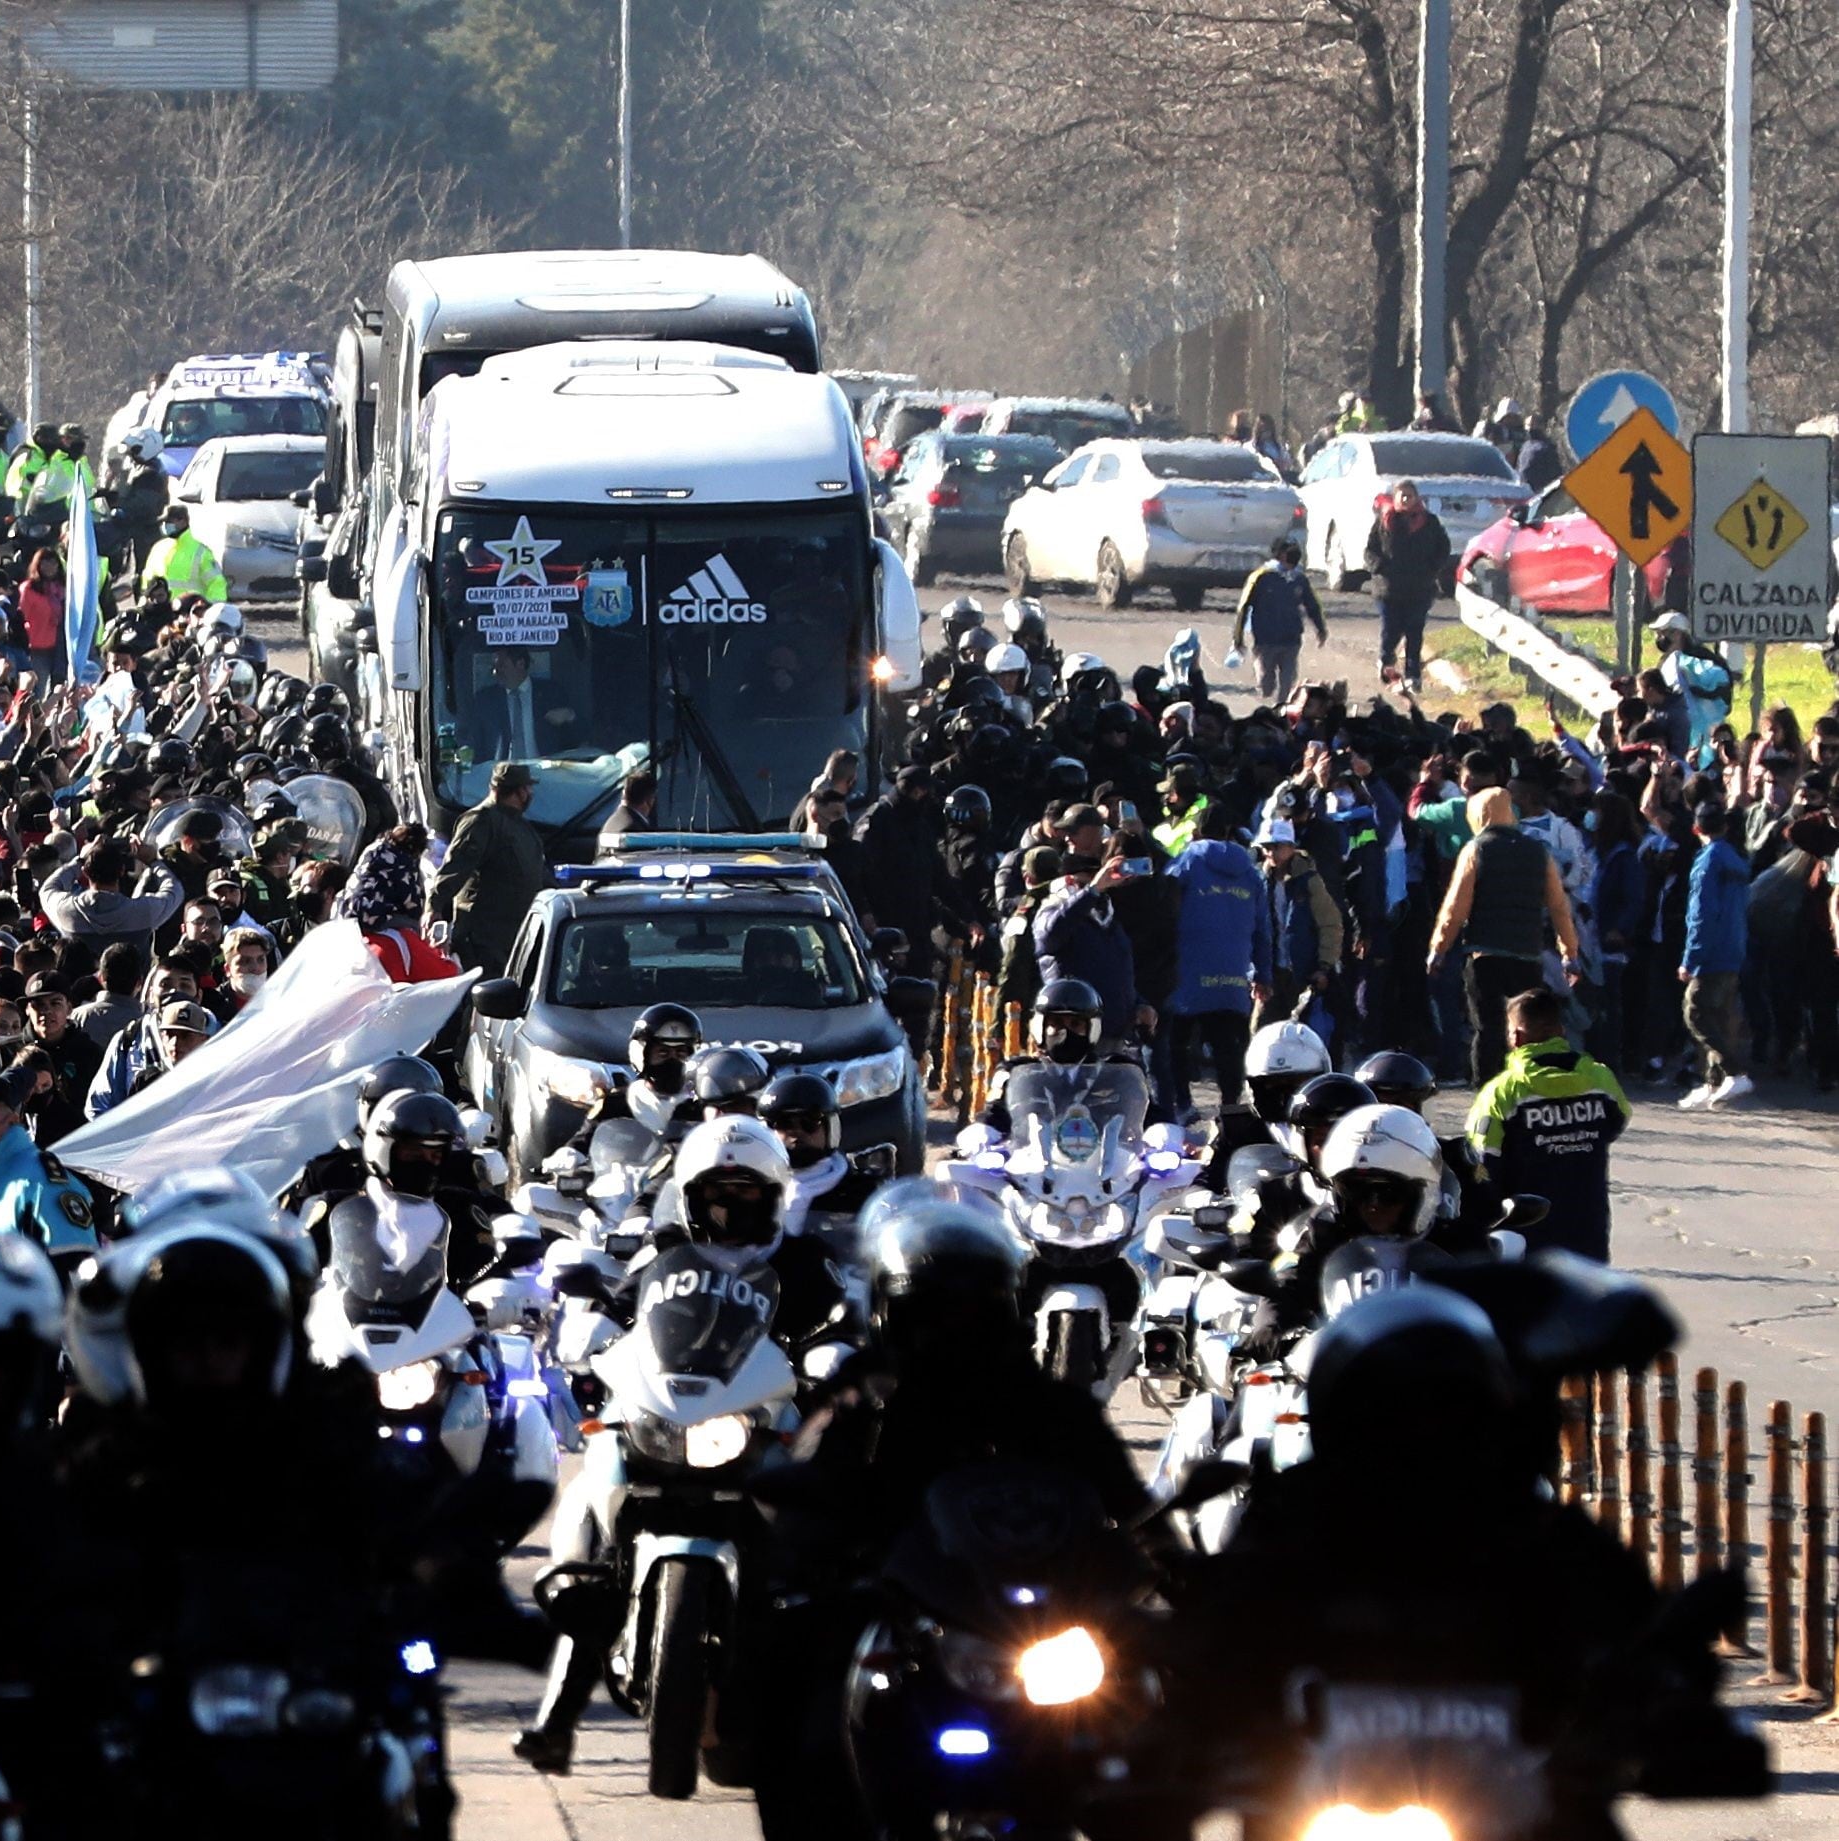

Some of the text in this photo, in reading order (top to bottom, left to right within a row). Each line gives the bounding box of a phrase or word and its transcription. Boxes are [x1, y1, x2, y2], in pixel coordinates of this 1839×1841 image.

[507, 547, 535, 566] 15
[468, 588, 522, 600] CAMPEONES
[524, 588, 535, 599] DE
[594, 590, 621, 613] AFA
[1699, 582, 1821, 606] CALZADA
[497, 602, 549, 614] 10/07/2021
[658, 599, 767, 624] adidas
[480, 617, 515, 629] ESTADIO
[1705, 614, 1815, 636] DIVIDIDA
[490, 630, 557, 642] RIO DE JANEIRO
[1526, 1101, 1606, 1129] POLICIA
